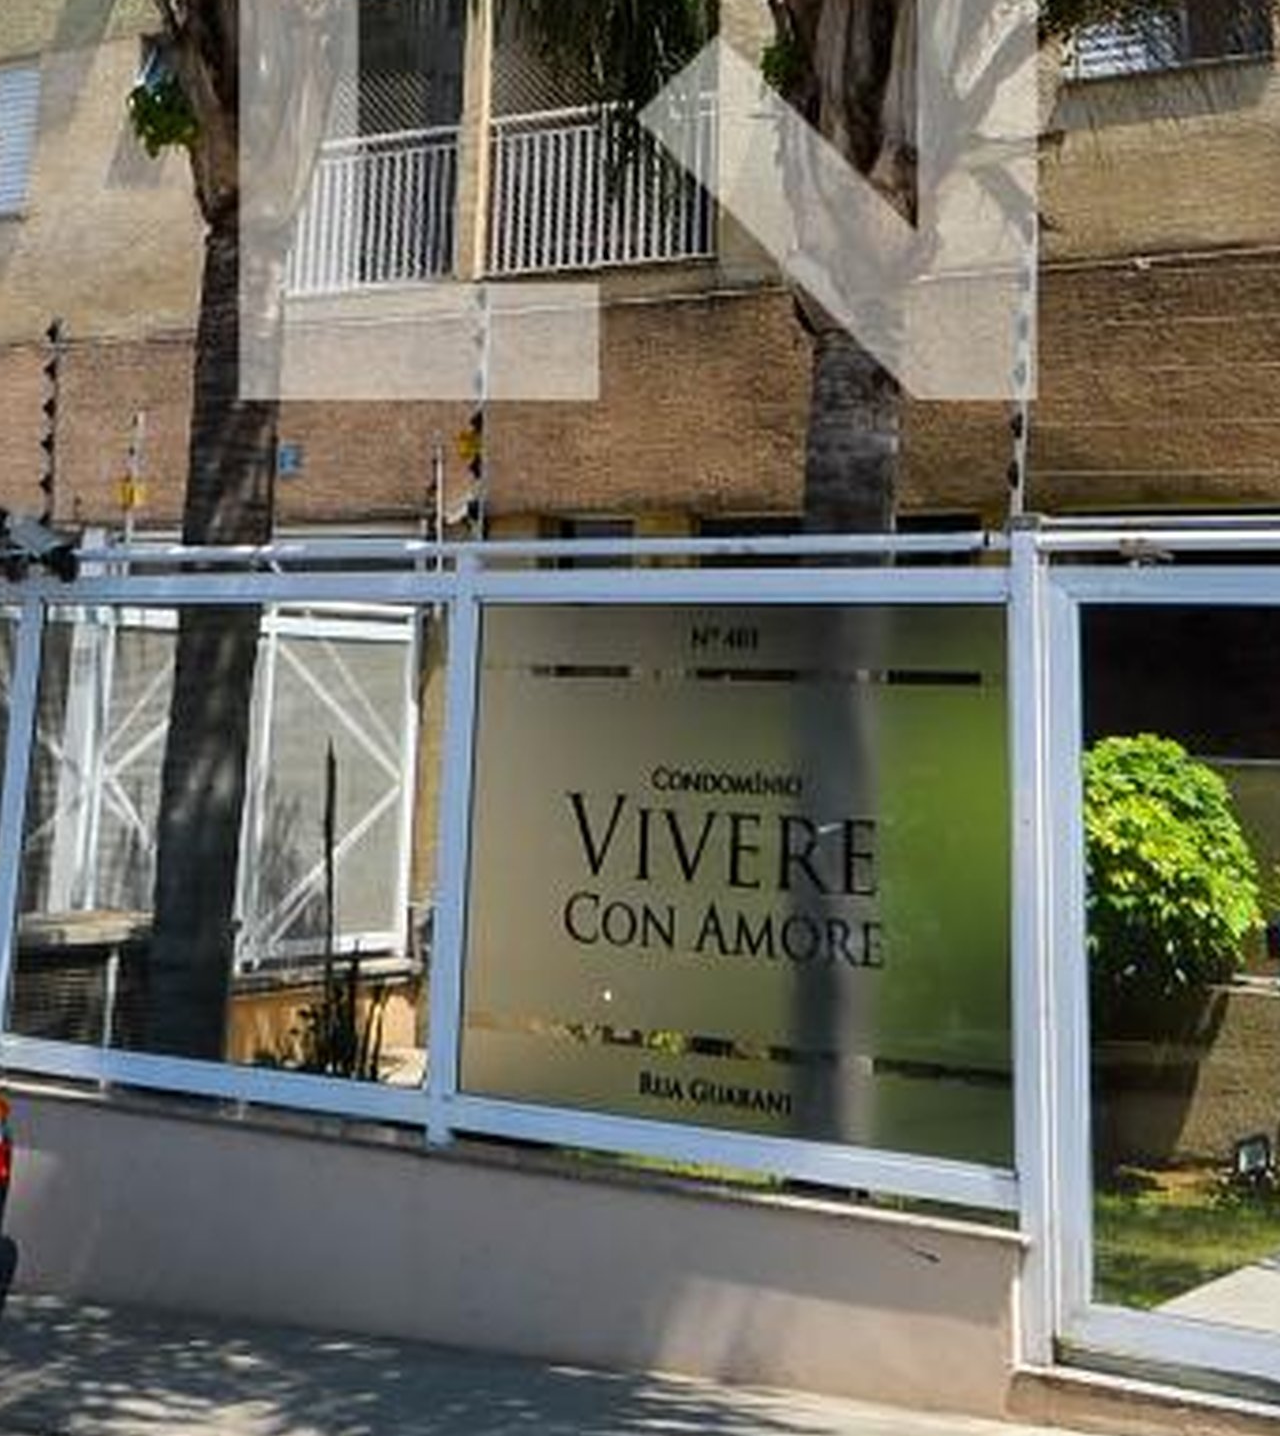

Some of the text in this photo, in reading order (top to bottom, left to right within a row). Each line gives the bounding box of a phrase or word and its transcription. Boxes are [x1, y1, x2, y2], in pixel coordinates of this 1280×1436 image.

[566, 792, 880, 897] VIVERE
[564, 891, 885, 969] CON AMORE
[688, 1078, 793, 1116] GUARANI
